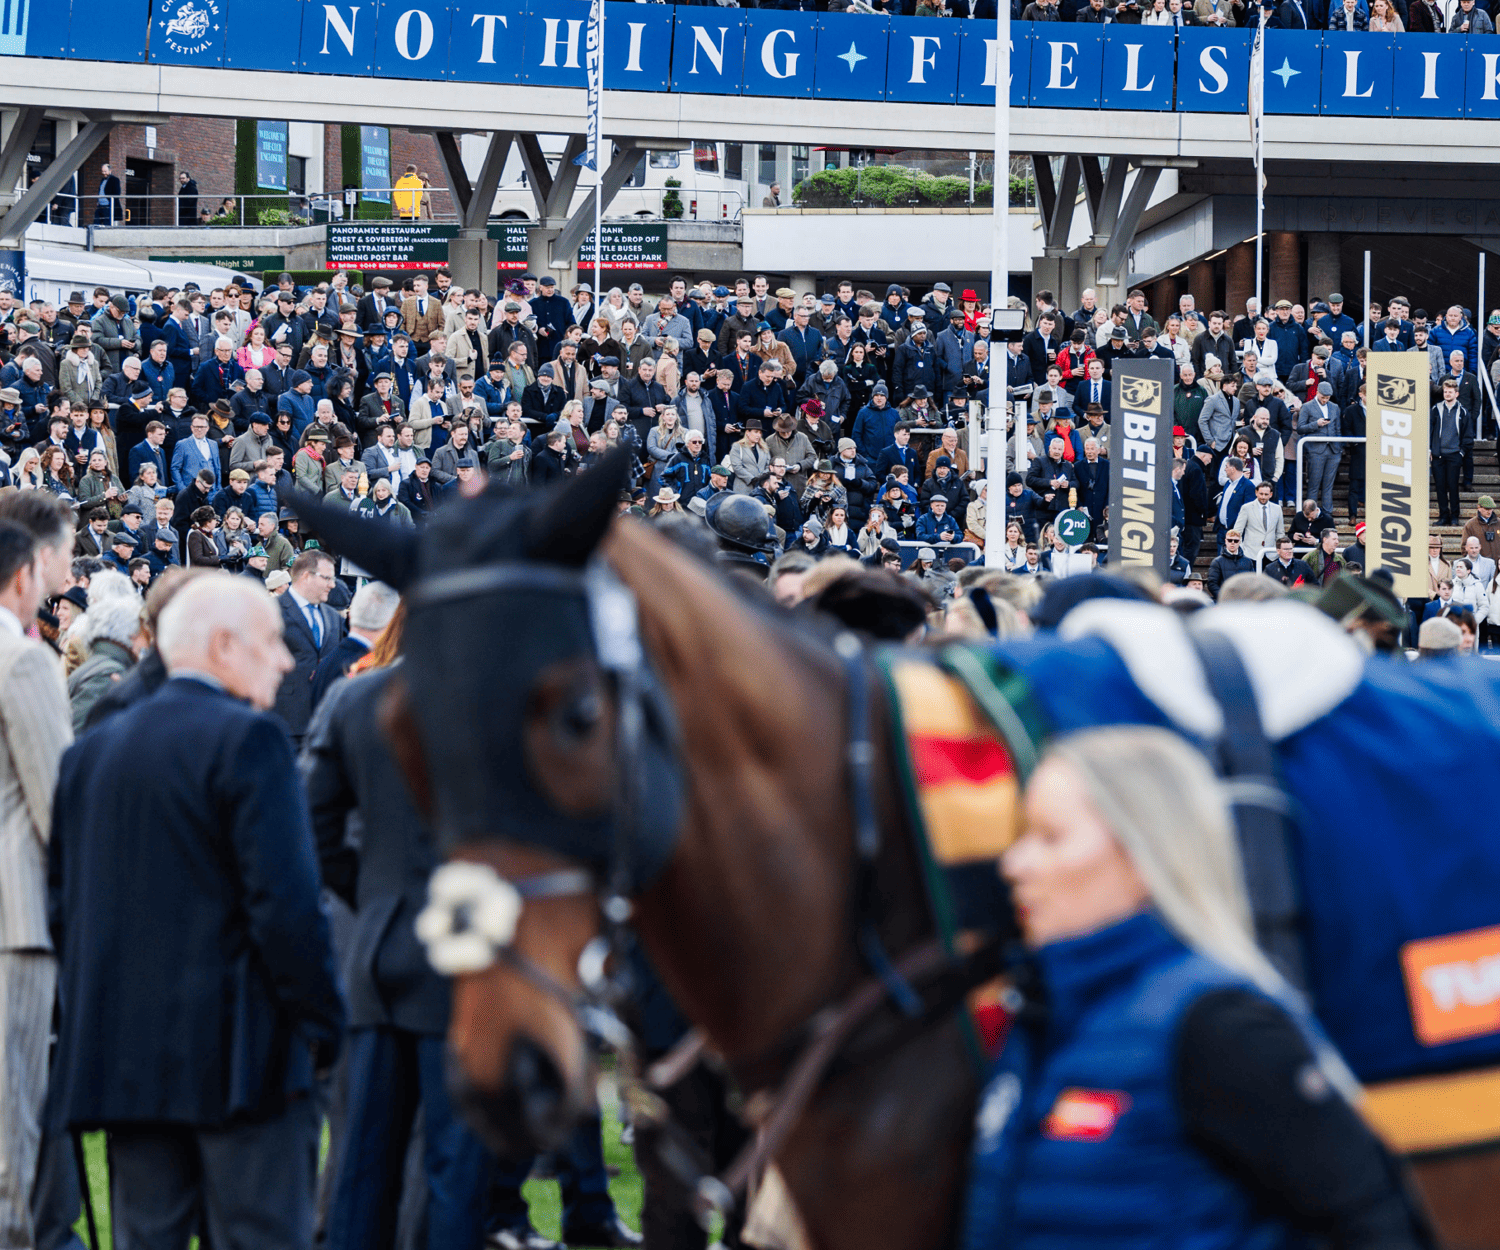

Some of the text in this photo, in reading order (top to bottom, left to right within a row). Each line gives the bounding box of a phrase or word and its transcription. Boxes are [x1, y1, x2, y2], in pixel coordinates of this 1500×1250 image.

[165, 37, 213, 55] FESTIVAL
[319, 3, 801, 79] NOTHING
[907, 35, 1229, 95] FEELS
[215, 260, 240, 269] Height
[1380, 409, 1412, 576] BETMGM
[1062, 518, 1087, 536] 2nd
